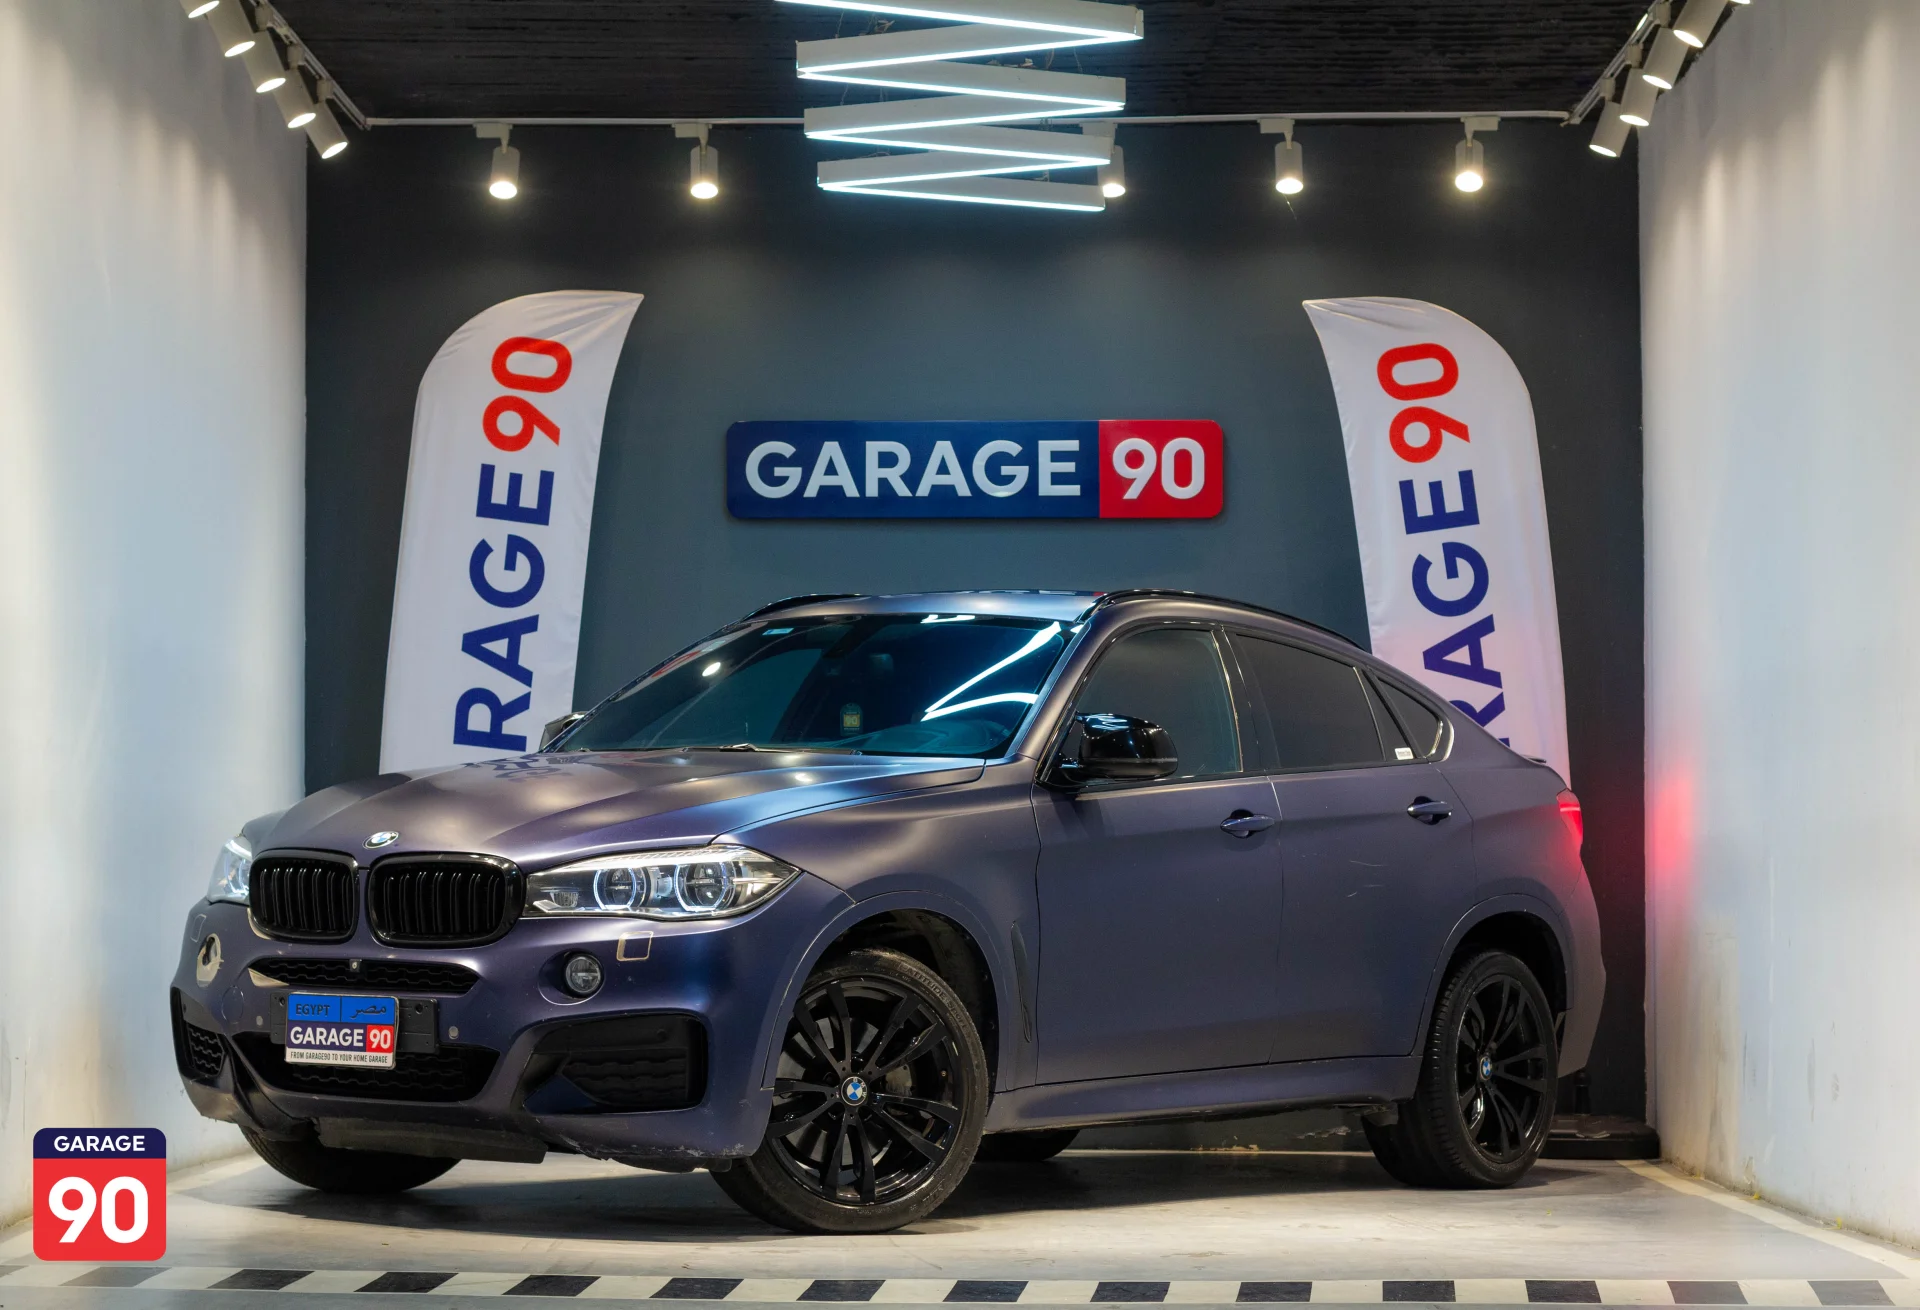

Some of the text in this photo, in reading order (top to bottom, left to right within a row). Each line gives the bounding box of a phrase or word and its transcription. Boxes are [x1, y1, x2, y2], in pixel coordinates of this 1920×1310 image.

[745, 437, 1205, 499] GARAGE 90
[295, 1003, 330, 1017] EGYPT
[350, 1005, 387, 1019] مصر
[290, 1026, 391, 1049] GARAGE 90
[290, 1051, 388, 1064] FROM GARAGE90 TO YOUR HOME GARAGE
